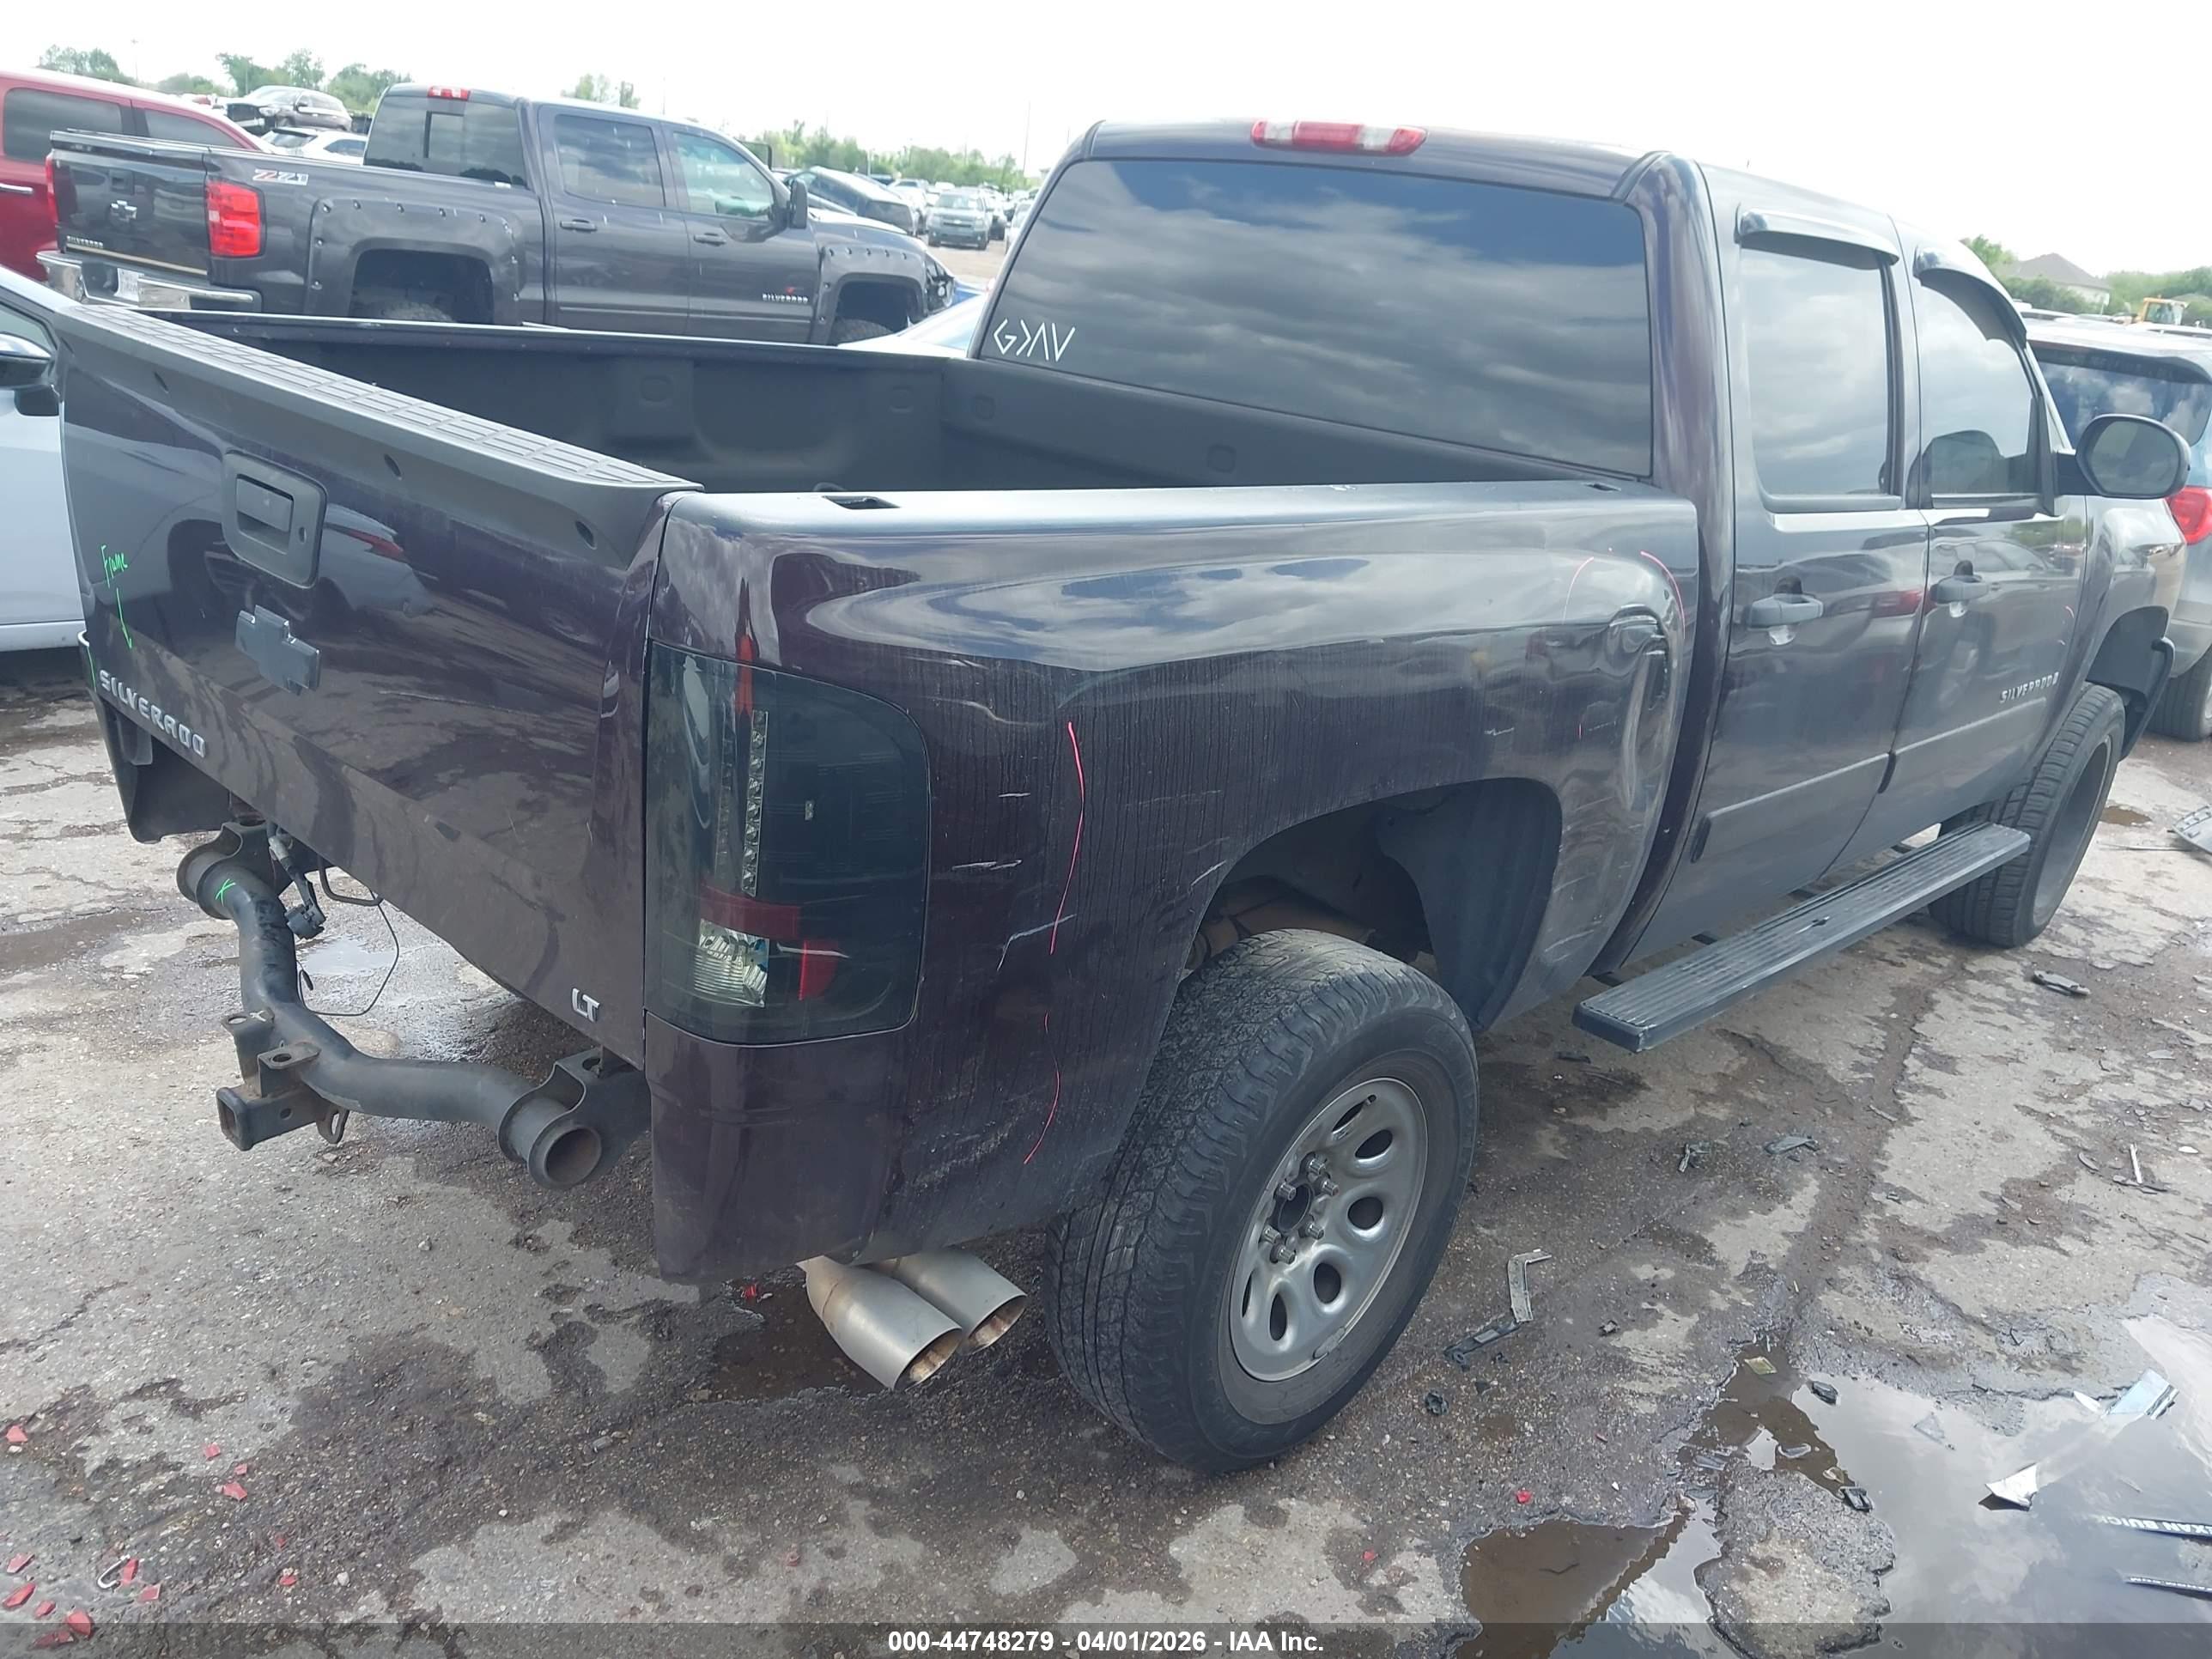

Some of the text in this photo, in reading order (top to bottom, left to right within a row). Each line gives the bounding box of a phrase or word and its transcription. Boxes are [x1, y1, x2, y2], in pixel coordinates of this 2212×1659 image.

[252, 168, 309, 186] Z71
[1999, 672, 2059, 704] SILVERADO
[100, 669, 205, 758] SILVERADO
[571, 988, 600, 1023] LT
